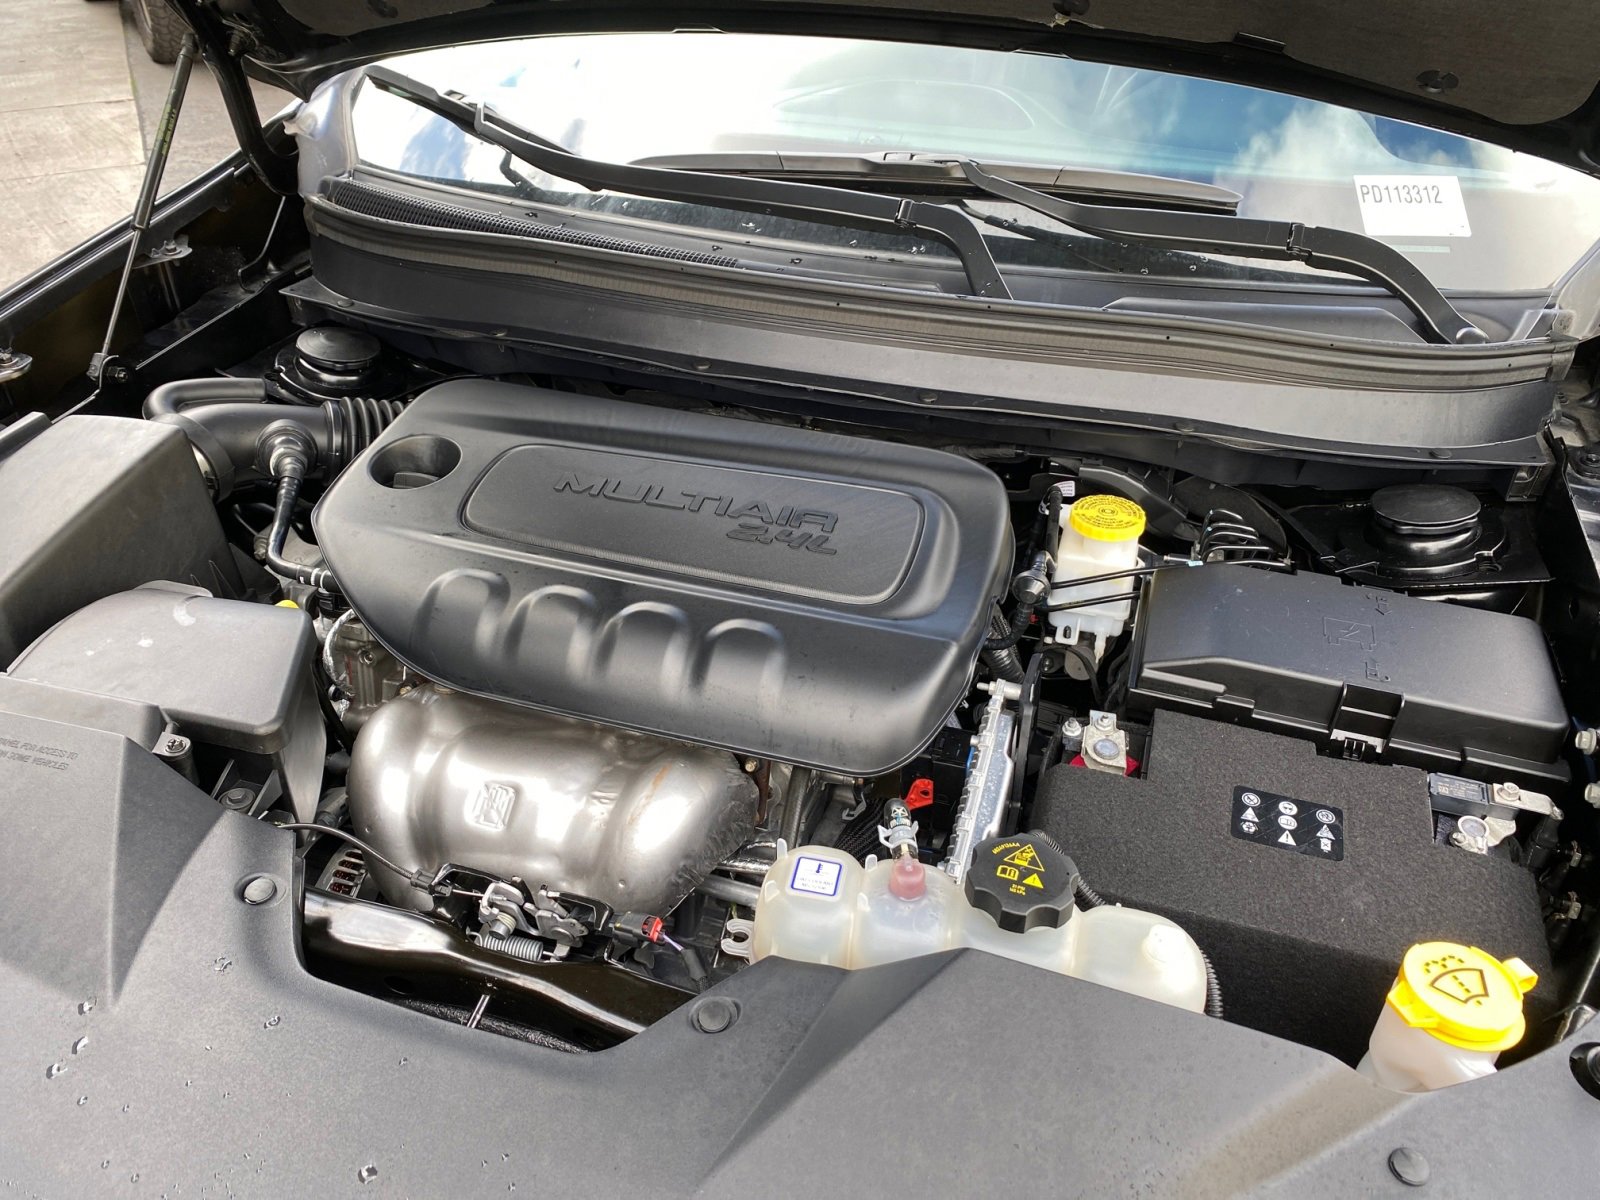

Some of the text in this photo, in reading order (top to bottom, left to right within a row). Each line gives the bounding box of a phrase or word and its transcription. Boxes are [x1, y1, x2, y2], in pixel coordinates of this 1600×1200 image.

[1360, 184, 1443, 204] PD113312
[552, 473, 839, 534] MULTIAIR
[726, 522, 838, 555] 2.4L
